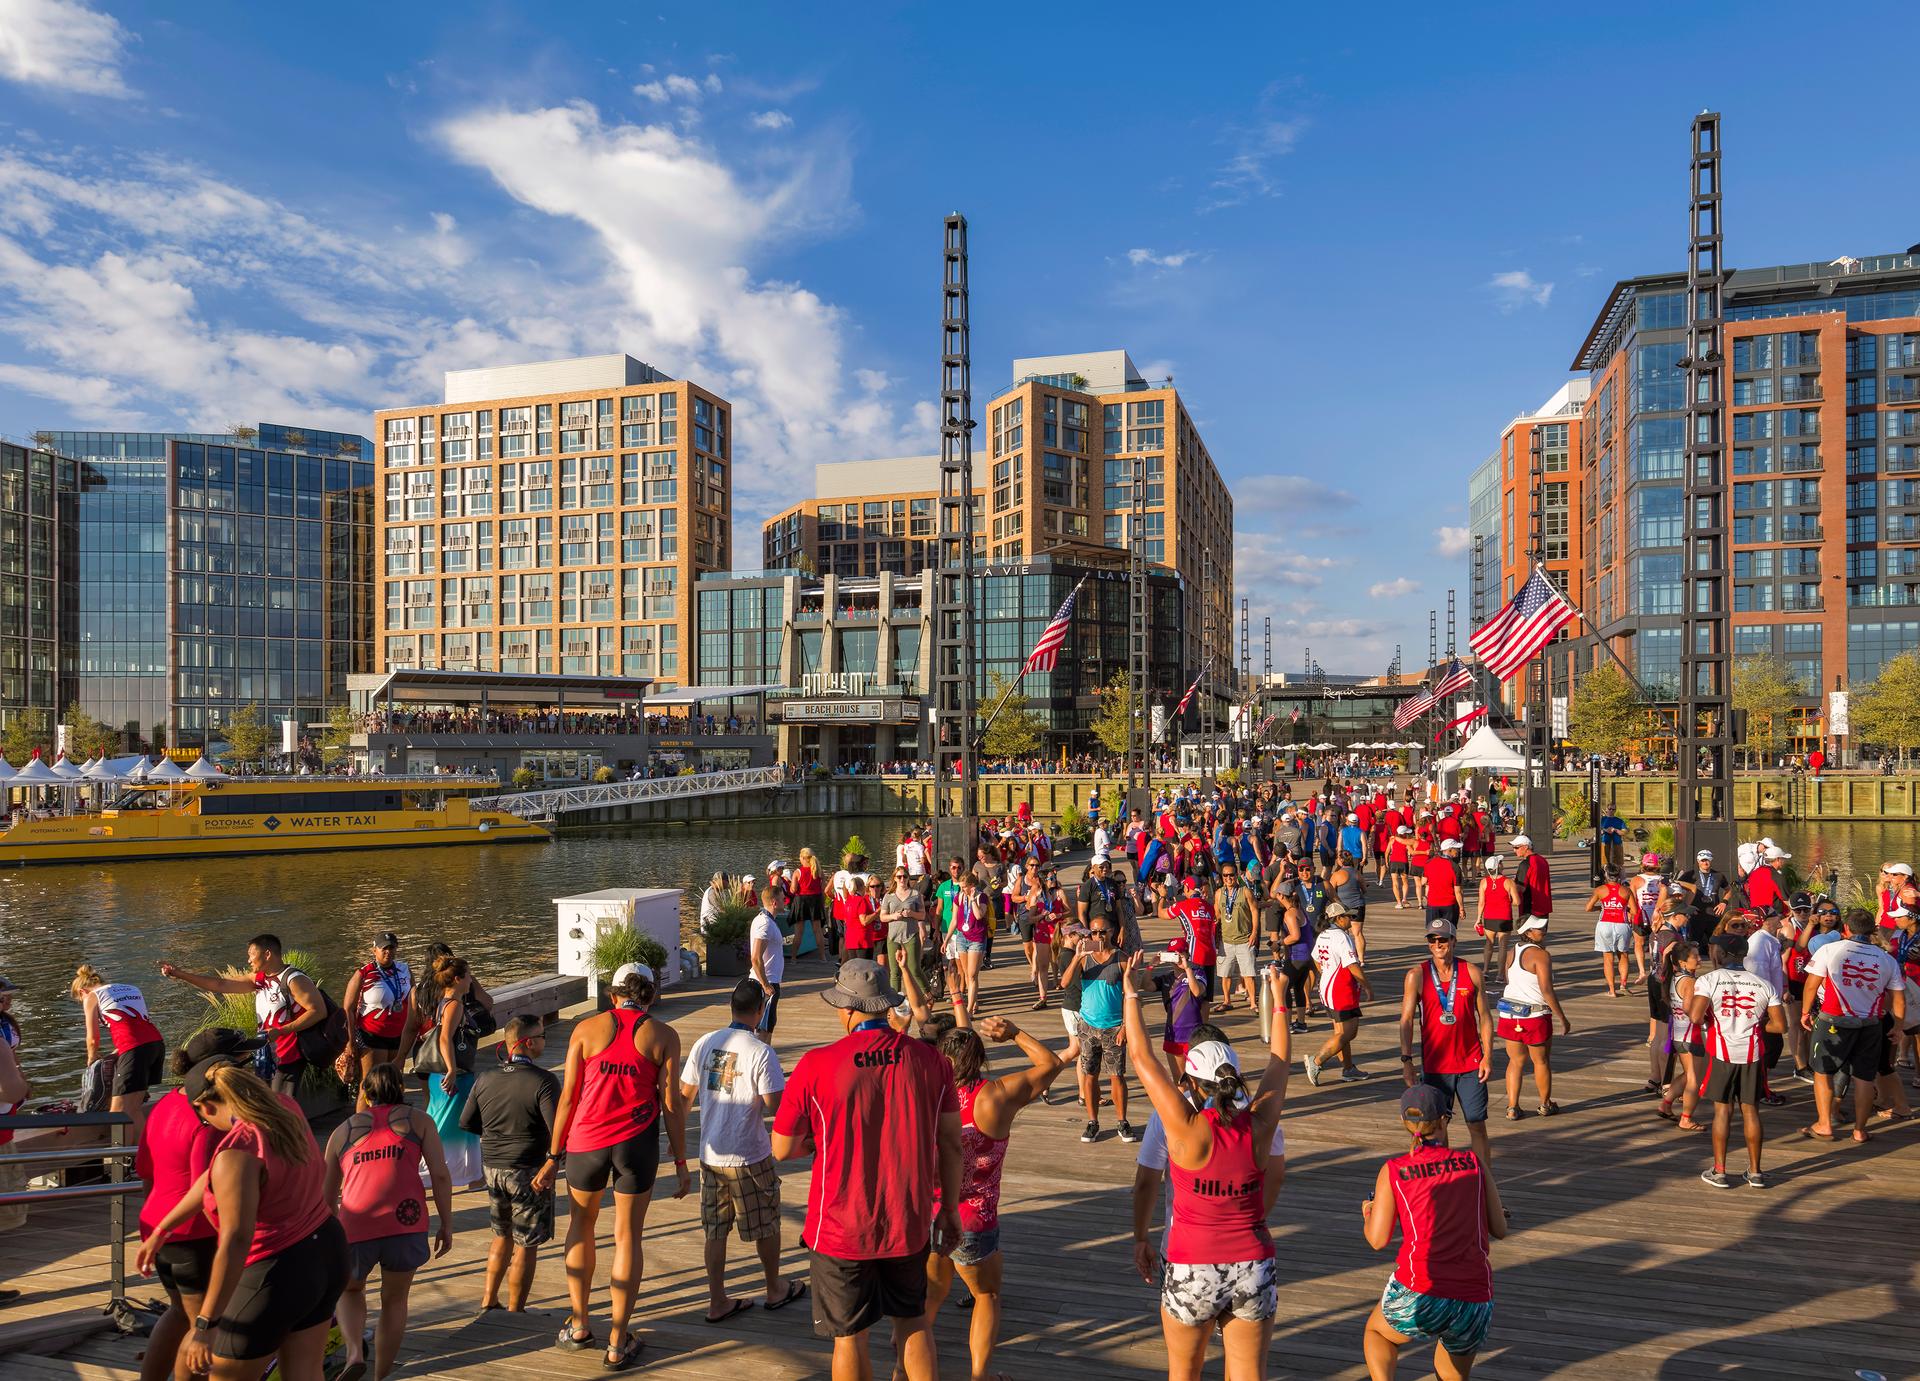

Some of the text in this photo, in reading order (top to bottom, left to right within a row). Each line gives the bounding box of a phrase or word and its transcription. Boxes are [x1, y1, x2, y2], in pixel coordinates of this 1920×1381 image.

[1002, 566, 1029, 576] VIE
[1097, 570, 1115, 580] LA
[802, 672, 863, 697] ANTHEM
[805, 704, 860, 714] BEACH HOUSE
[204, 819, 255, 827] POTOMAC
[290, 815, 377, 827] WATER TAXI
[1191, 909, 1212, 919] USA
[854, 1048, 902, 1068] CHIEF
[599, 1061, 638, 1076] Unite
[353, 1144, 406, 1165] Emsilly
[1399, 1151, 1476, 1181] CHIEFTESS
